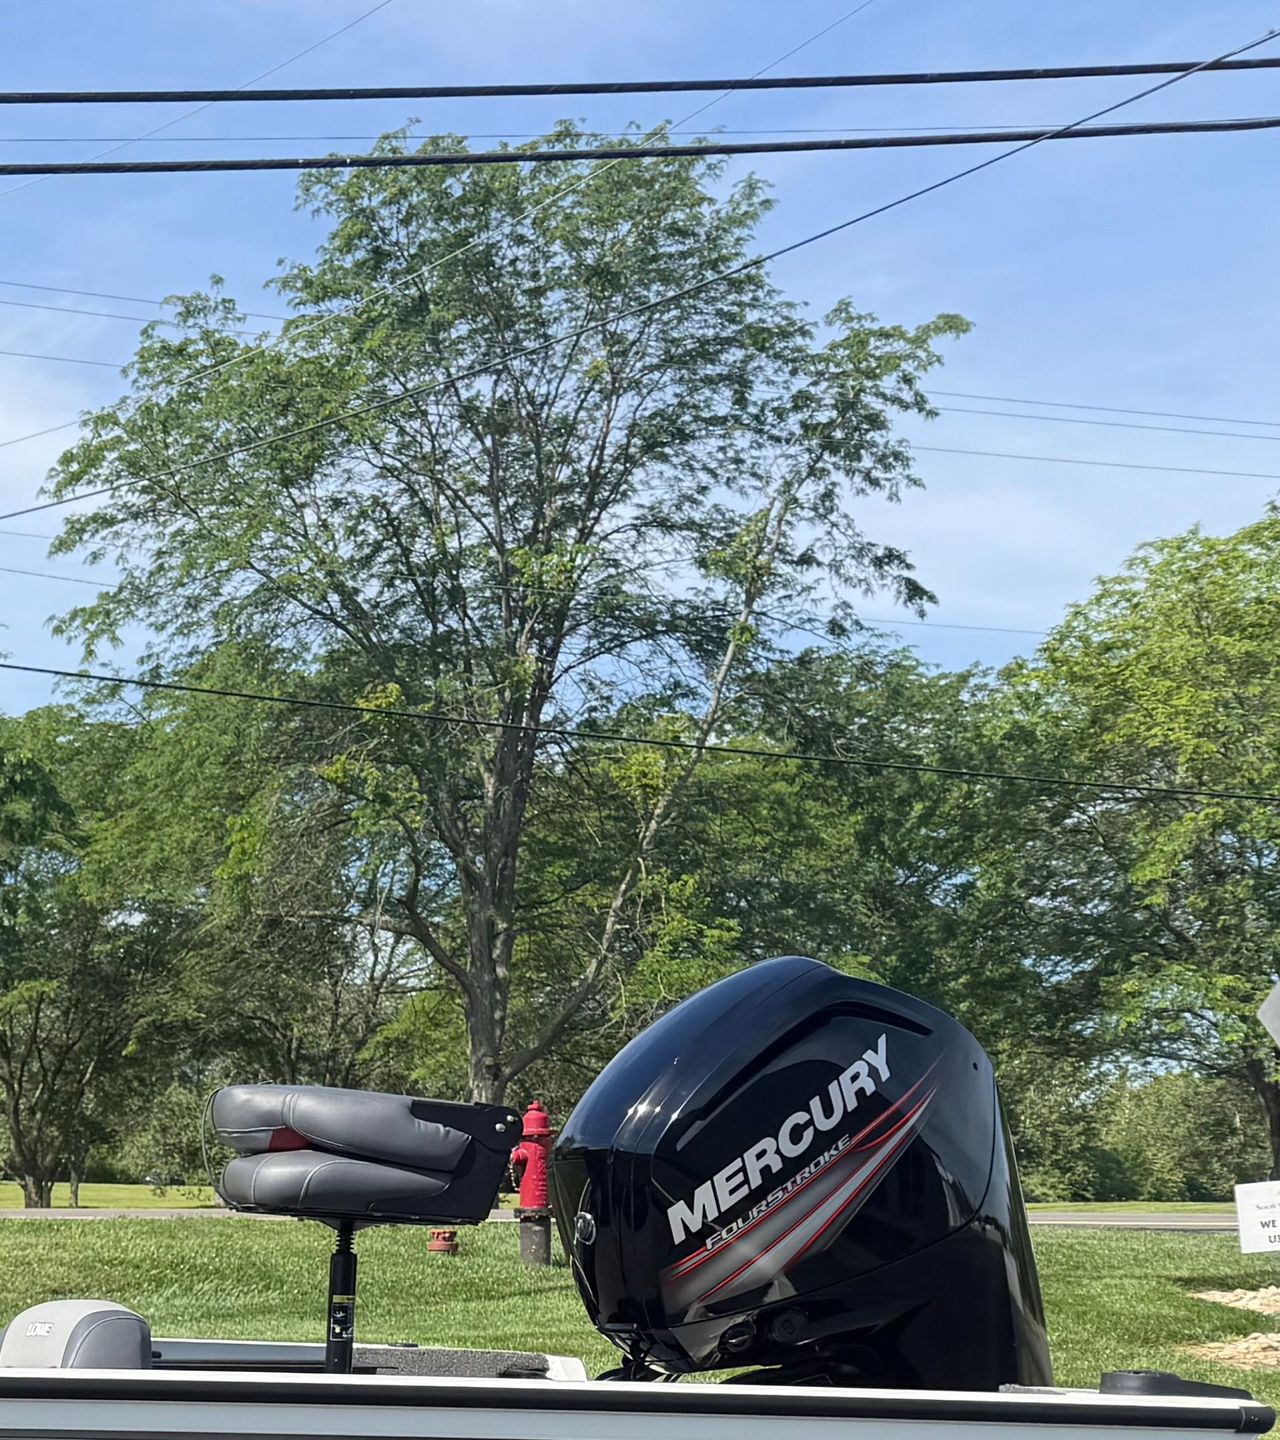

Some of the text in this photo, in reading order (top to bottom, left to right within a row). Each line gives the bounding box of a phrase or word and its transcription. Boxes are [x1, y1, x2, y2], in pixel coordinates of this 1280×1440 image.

[666, 1032, 892, 1246] MERCURY
[704, 1132, 853, 1251] FOURSTROKE
[1260, 1219, 1278, 1229] WE
